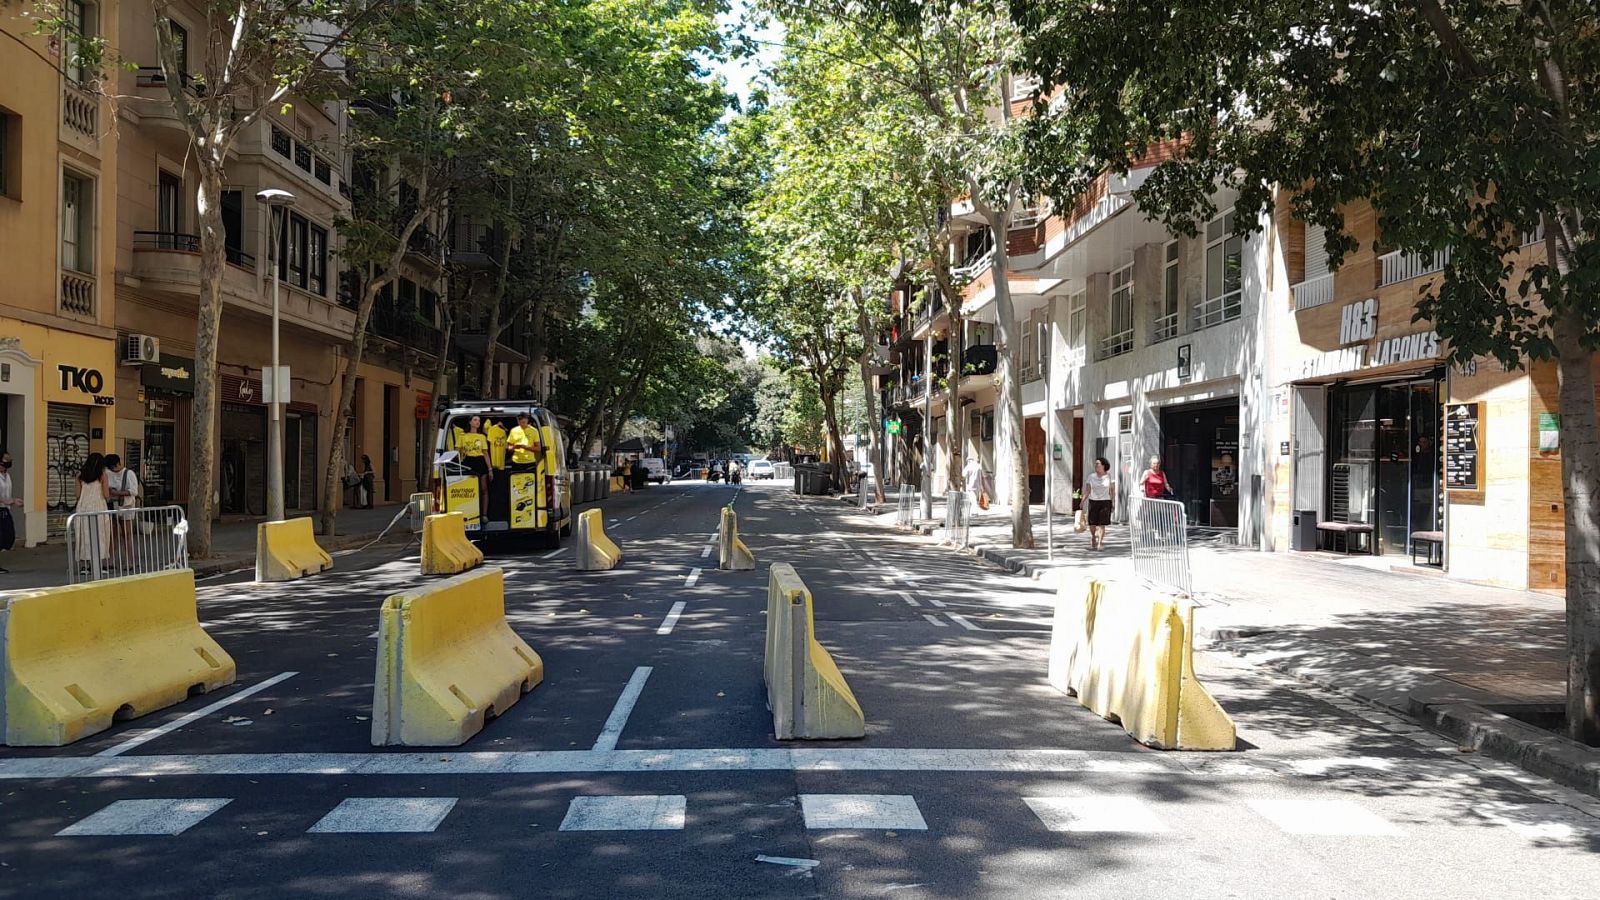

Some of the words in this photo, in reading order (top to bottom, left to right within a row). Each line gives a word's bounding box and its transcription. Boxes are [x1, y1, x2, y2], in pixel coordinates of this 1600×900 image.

[1340, 298, 1378, 345] H83
[1289, 345, 1368, 380] STAURANT
[57, 364, 103, 394] TKO
[93, 395, 115, 406] TACOS
